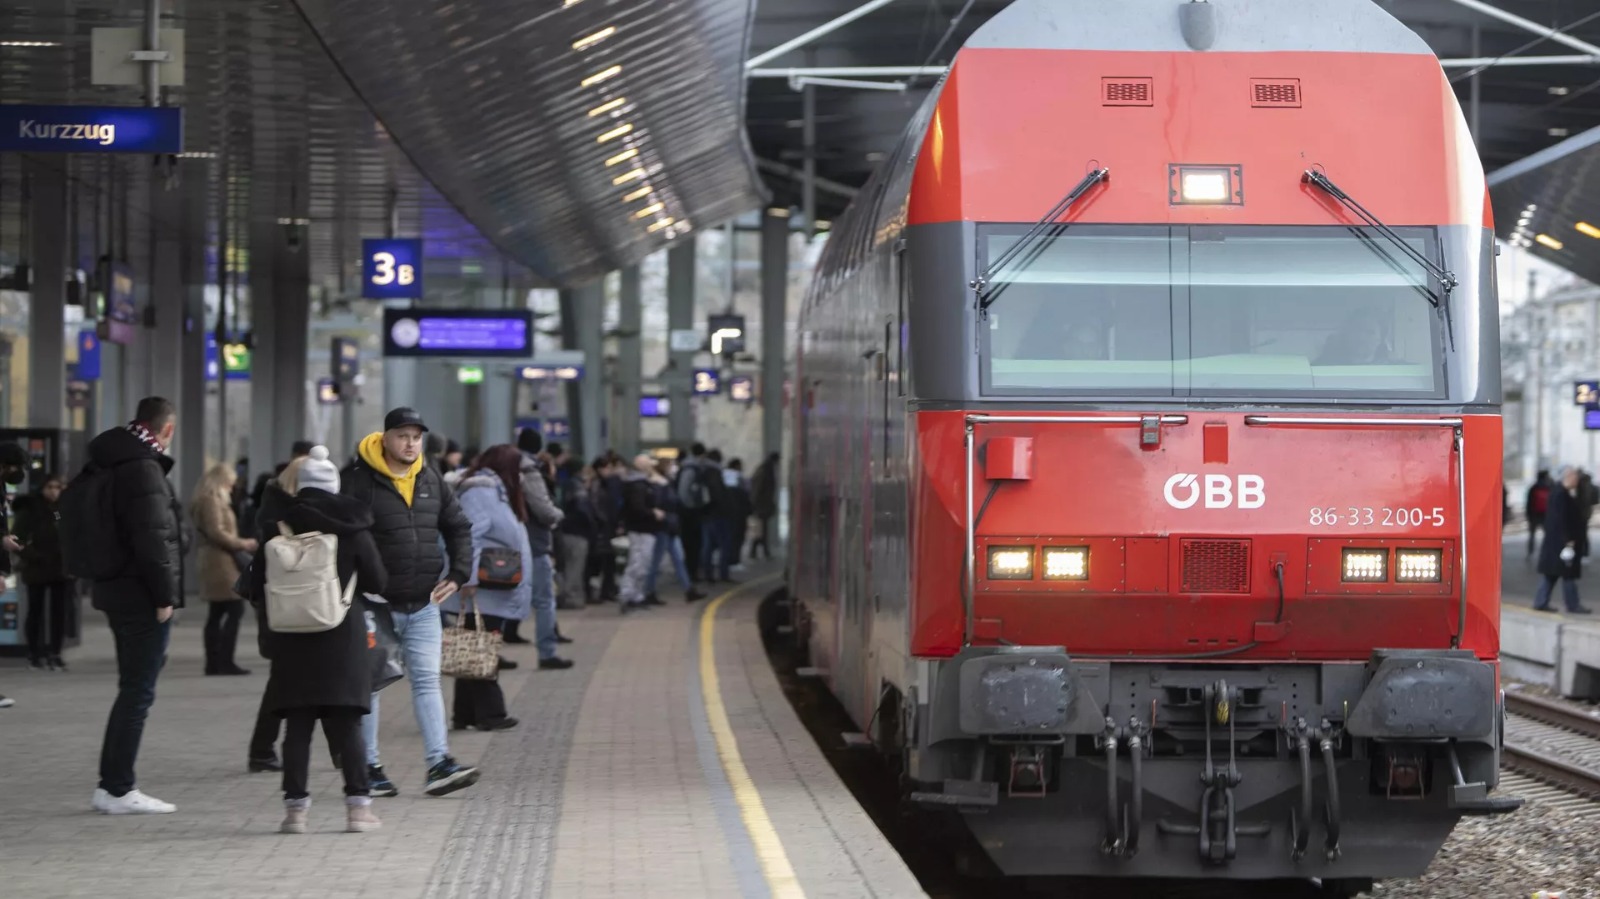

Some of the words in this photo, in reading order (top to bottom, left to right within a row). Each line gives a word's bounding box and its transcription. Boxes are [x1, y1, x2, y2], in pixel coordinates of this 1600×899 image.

[19, 120, 115, 145] Kurzzug
[371, 252, 416, 286] 3B
[1163, 473, 1266, 509] ÖBB
[1309, 507, 1374, 526] 86-33
[1381, 507, 1445, 526] 200-5
